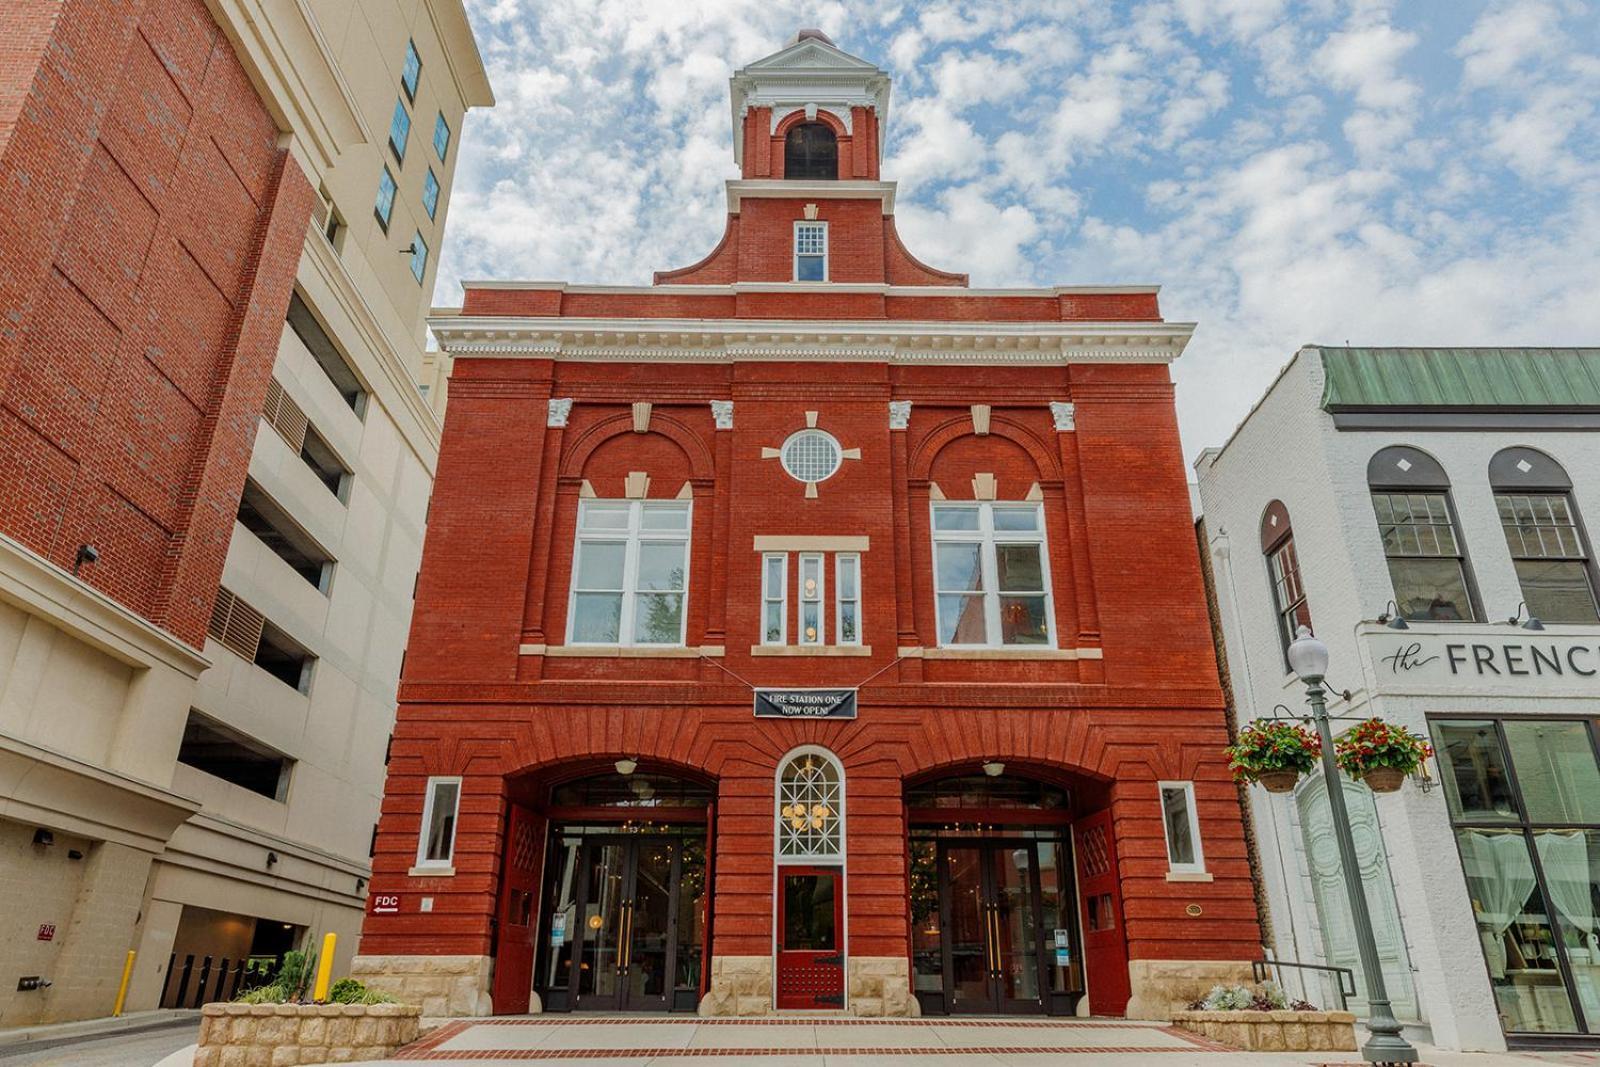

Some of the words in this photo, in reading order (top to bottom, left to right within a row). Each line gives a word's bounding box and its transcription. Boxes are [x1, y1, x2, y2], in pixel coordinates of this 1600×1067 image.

[1381, 643, 1440, 674] the
[1446, 644, 1600, 676] FRENC
[769, 695, 787, 703] FIRE
[790, 695, 823, 704] STATION
[825, 696, 842, 704] ONE
[782, 705, 802, 715] NOW
[803, 706, 829, 715] OPEN!
[375, 896, 398, 906] FDC
